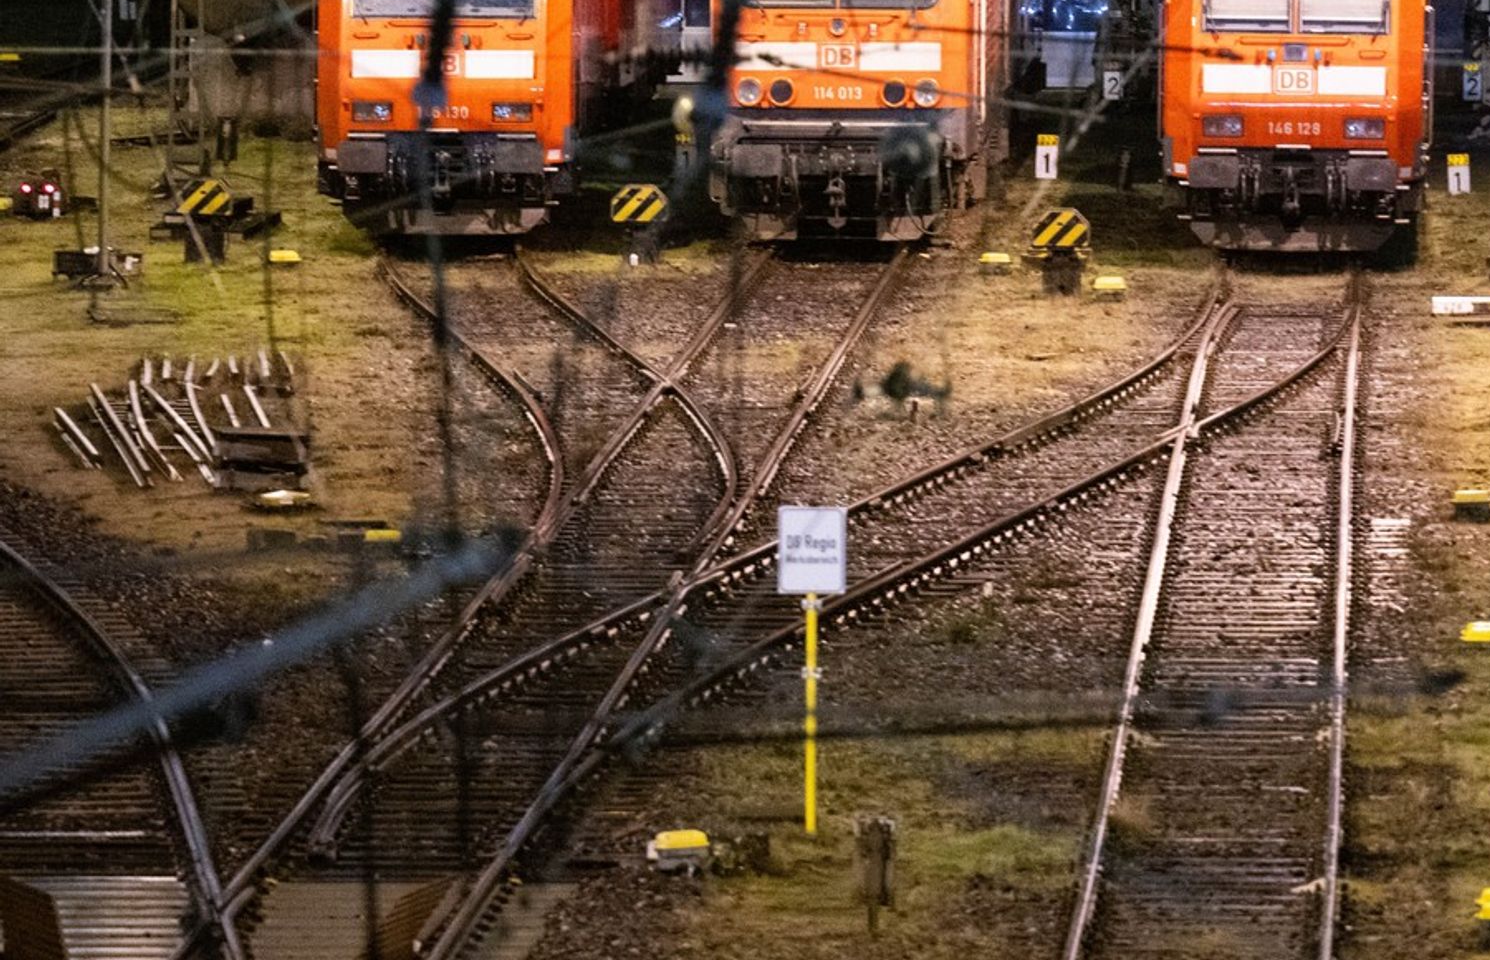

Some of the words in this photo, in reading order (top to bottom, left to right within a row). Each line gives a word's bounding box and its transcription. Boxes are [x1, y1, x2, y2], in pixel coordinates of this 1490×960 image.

[824, 47, 853, 65] DB
[1108, 76, 1121, 96] 2
[1281, 71, 1310, 89] DB
[1466, 77, 1479, 96] 2
[813, 85, 835, 100] 114
[837, 85, 863, 100] 013
[1268, 121, 1293, 136] 146
[1297, 121, 1322, 136] 128
[804, 534, 836, 552] Regio
